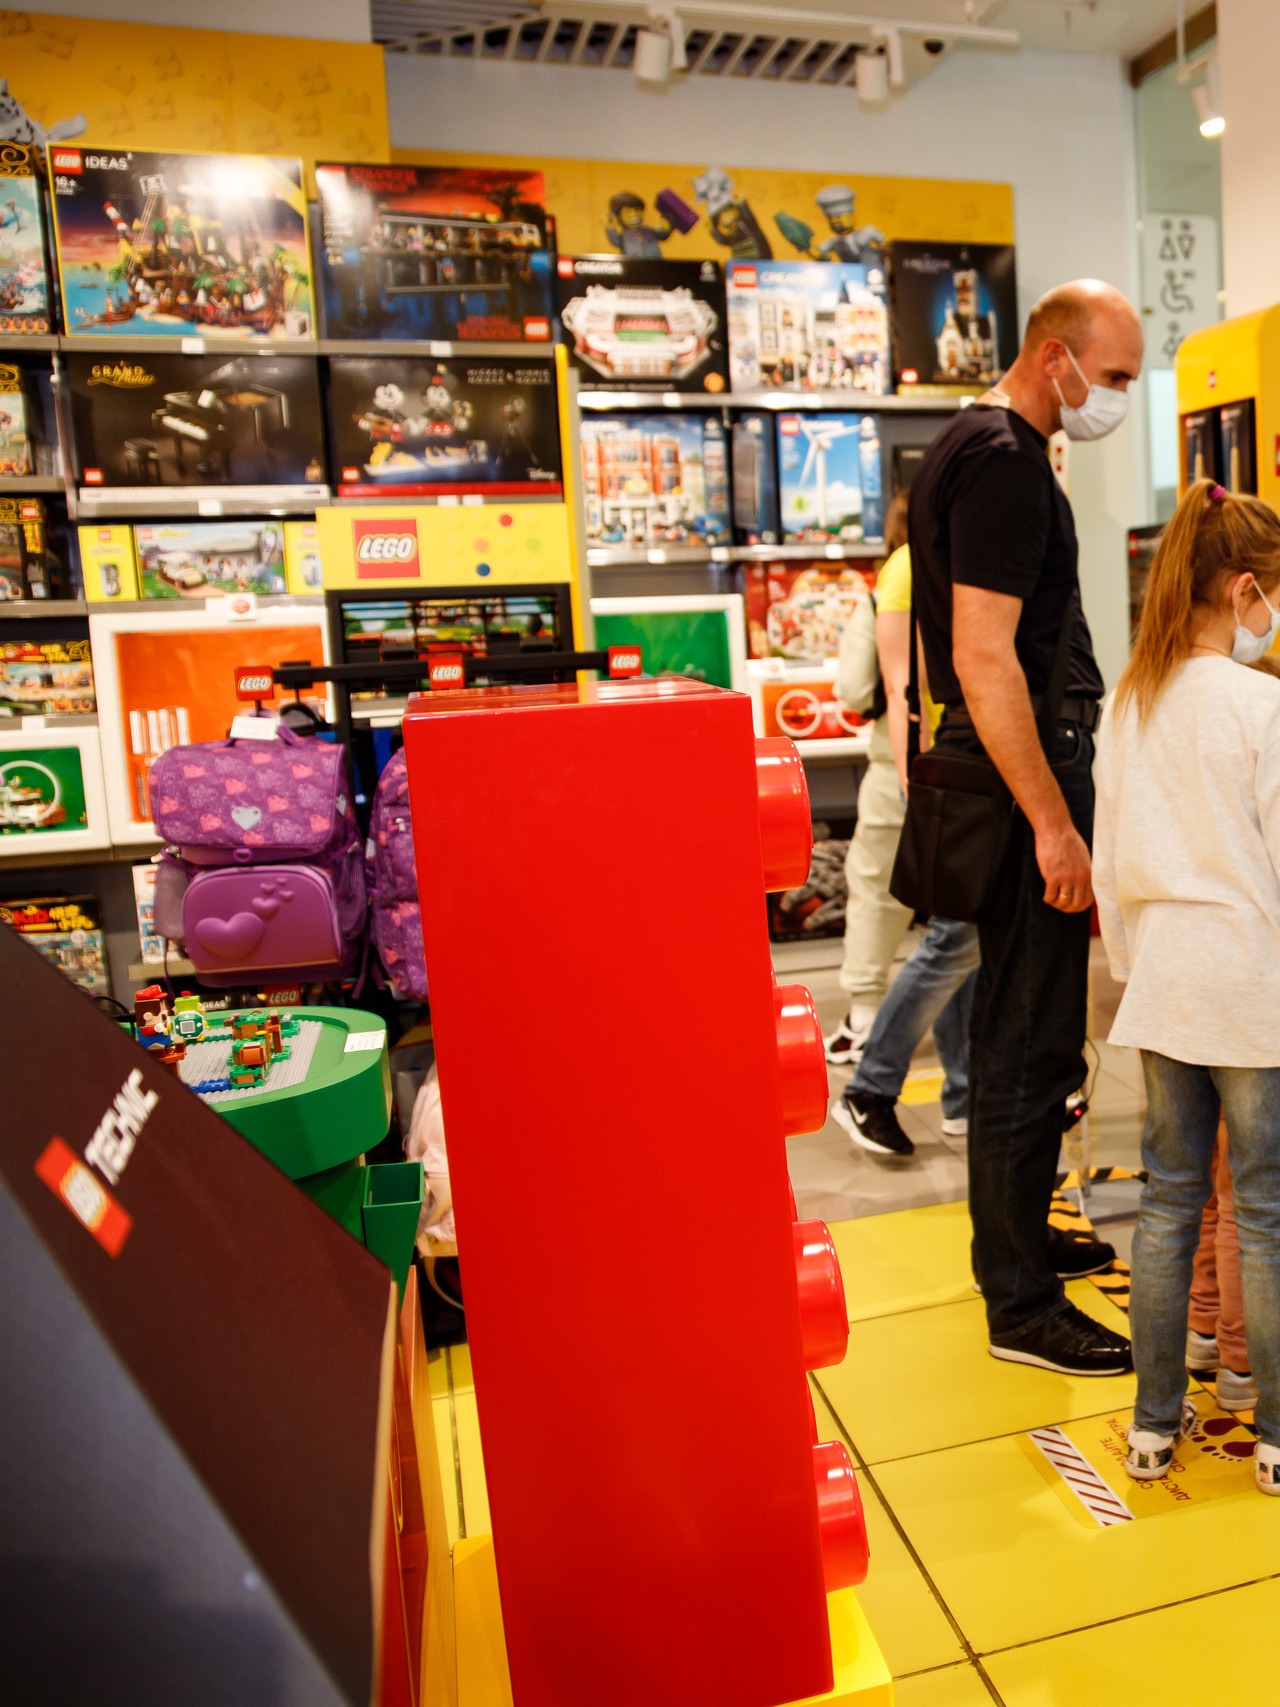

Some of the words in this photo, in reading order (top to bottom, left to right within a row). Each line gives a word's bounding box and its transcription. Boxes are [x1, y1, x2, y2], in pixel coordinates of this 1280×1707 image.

[85, 156, 128, 170] IDEAS
[92, 365, 145, 378] GRAND
[358, 536, 415, 560] LEGO
[612, 655, 639, 669] LEGO
[433, 665, 461, 680] LEGO
[239, 676, 270, 691] LEGO
[269, 991, 299, 1005] LEGO
[84, 1068, 159, 1186] TECHNIC
